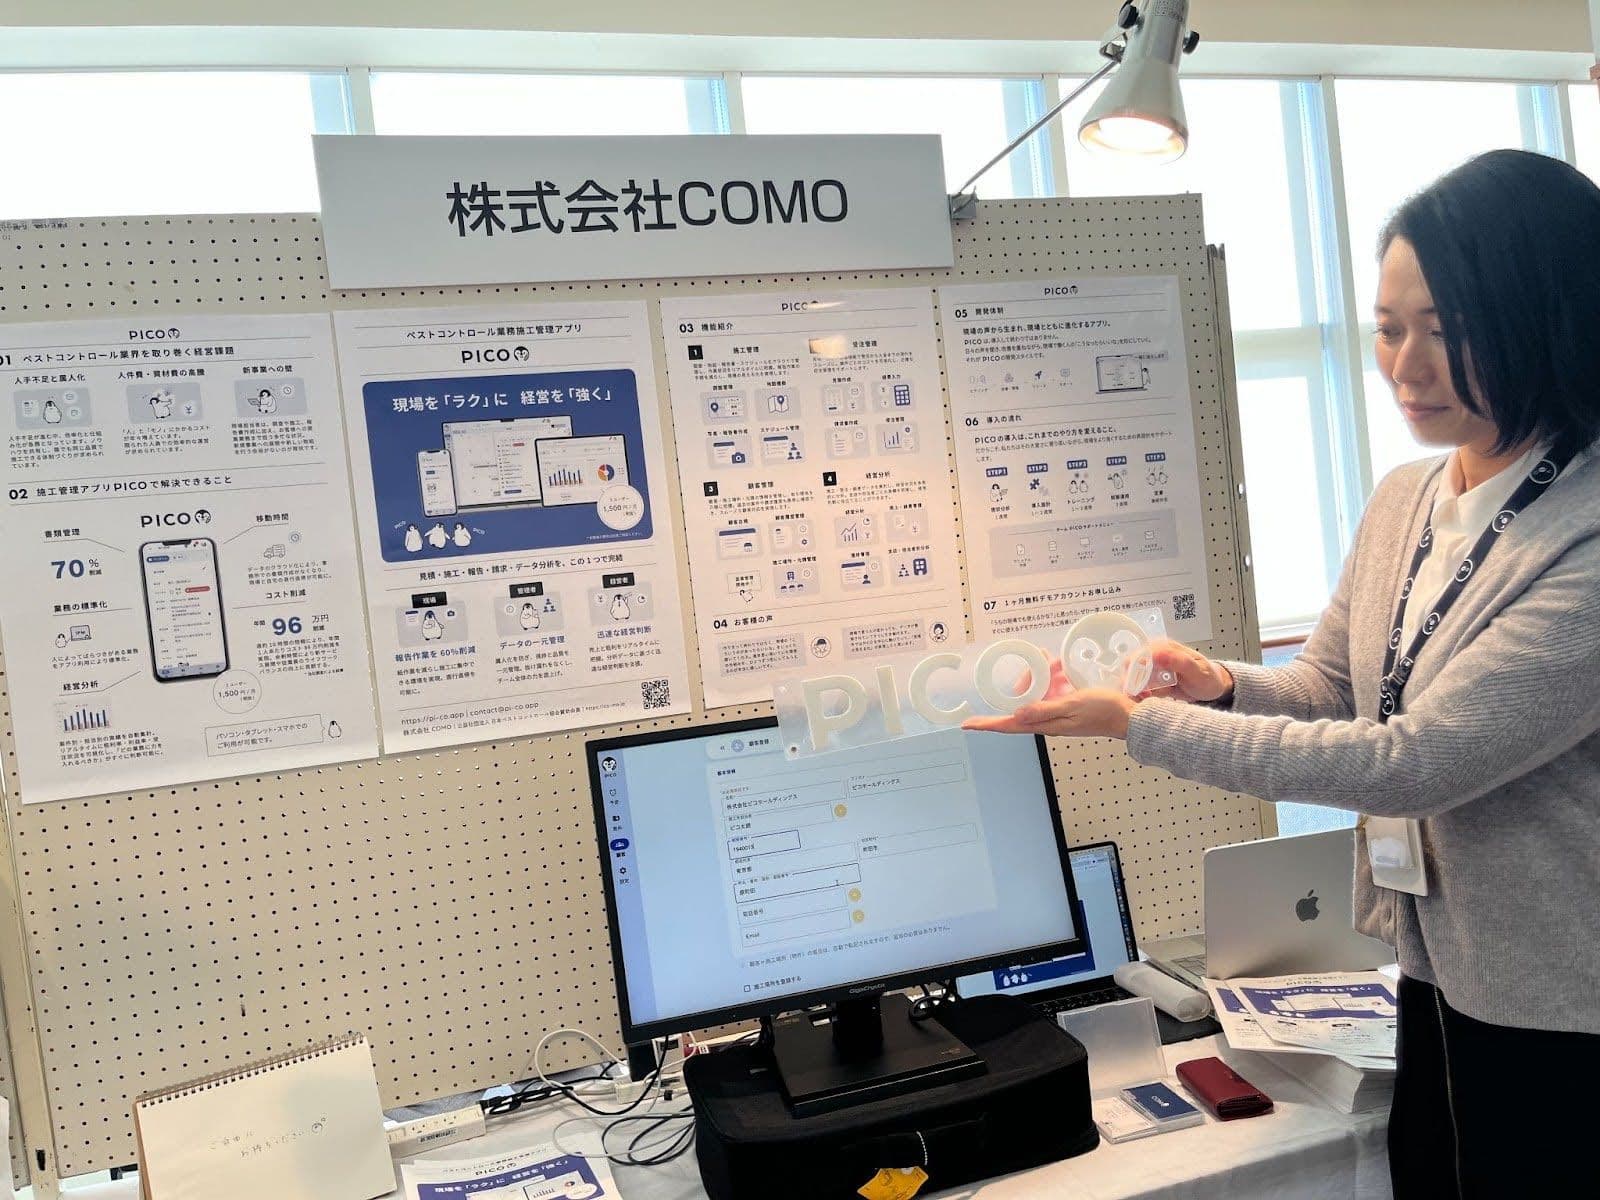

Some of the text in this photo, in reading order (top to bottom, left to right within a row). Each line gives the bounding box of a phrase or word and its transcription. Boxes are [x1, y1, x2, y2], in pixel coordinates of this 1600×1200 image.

[447, 179, 848, 237] 株式会社COMO
[1044, 287, 1069, 296] PICO
[955, 309, 968, 318] 05
[679, 322, 733, 333] 03 機能紹介
[129, 330, 166, 340] PICO
[461, 349, 510, 363] PICO
[733, 346, 759, 354] 施工管理
[14, 374, 86, 385] 人手不足と属人化
[392, 387, 612, 412] 現場を「ラク」に 経営を「強く」
[965, 414, 1022, 426] 06 導入の流れ
[9, 476, 232, 500] 02 施工管理アプリPICOで解決できること
[141, 512, 191, 528] PICO
[255, 513, 289, 523] 移動時間
[51, 559, 99, 579] 70 %
[266, 589, 307, 599] コスト削減
[983, 586, 1121, 611] 07 1ヶ月無料デモアカウントお申し込み
[54, 601, 108, 613] 業務の標準化
[272, 616, 302, 636] 96
[312, 614, 329, 623] 万円
[713, 615, 773, 629] 04 お客様の声
[500, 635, 565, 650] データの一元管理
[63, 681, 99, 691] 経営分析
[802, 639, 1051, 751] PICO
[431, 724, 452, 732] COMO
